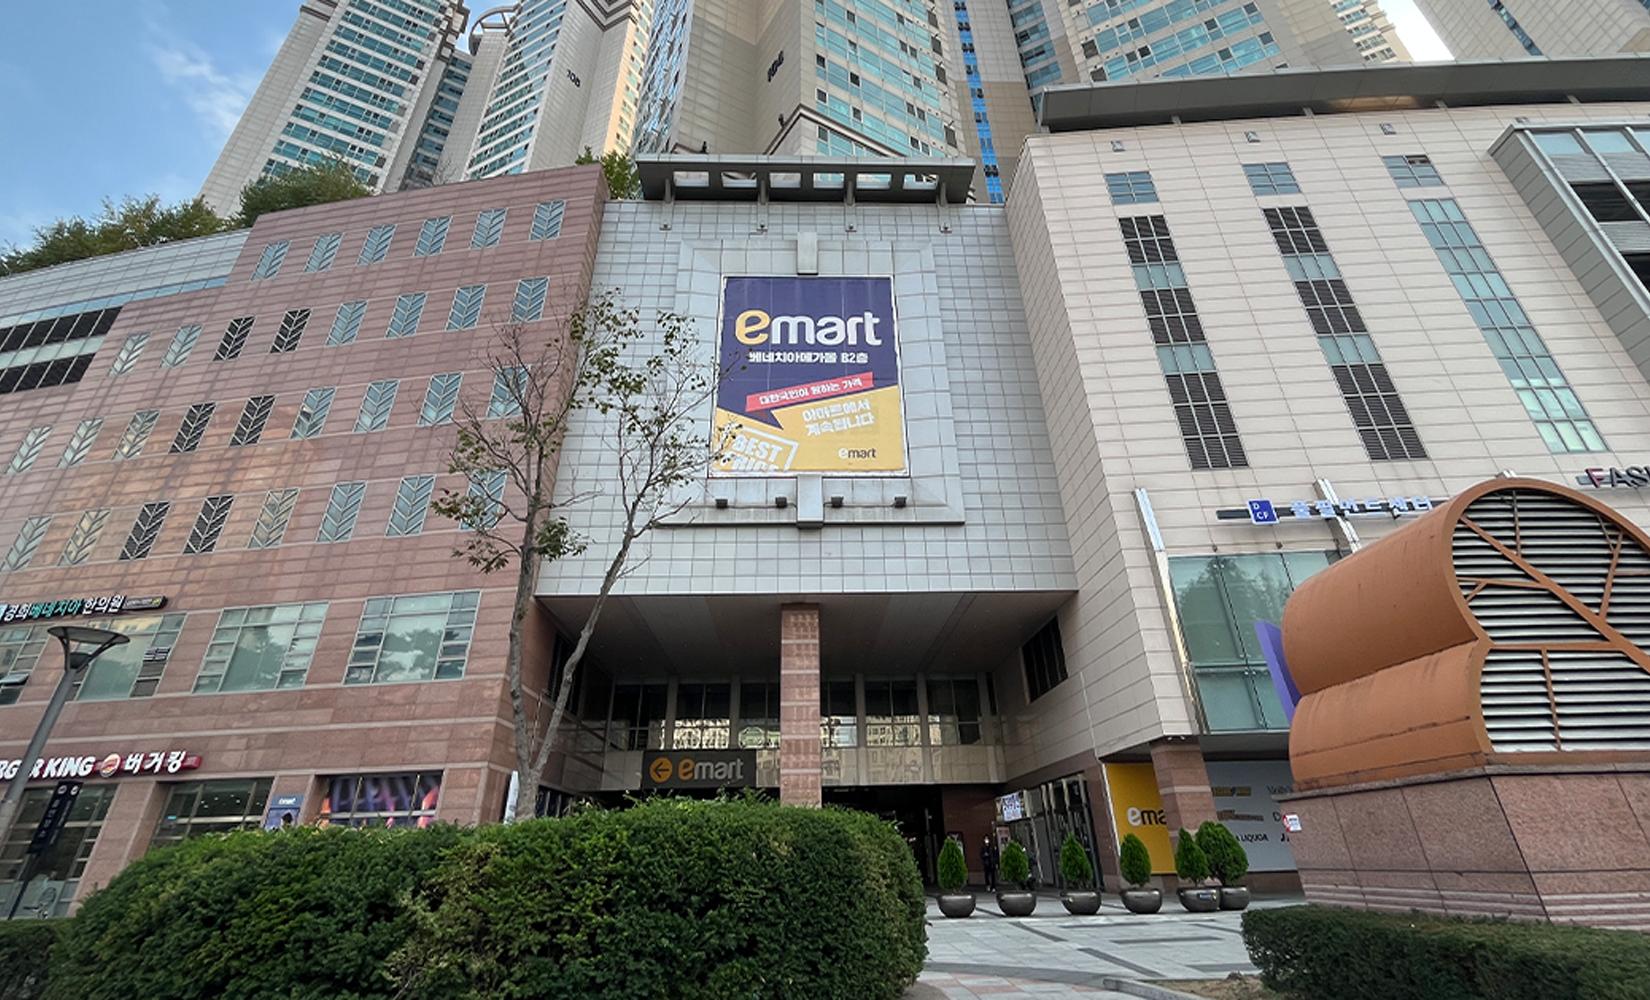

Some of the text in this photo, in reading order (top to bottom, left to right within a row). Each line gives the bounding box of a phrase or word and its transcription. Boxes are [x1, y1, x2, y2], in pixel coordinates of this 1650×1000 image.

[735, 309, 882, 345] emart
[732, 435, 783, 463] BEST
[838, 447, 877, 459] emart
[1585, 466, 1650, 488] FAS
[42, 756, 96, 779] KING
[124, 751, 186, 774] 버거킹
[678, 759, 744, 780] emart
